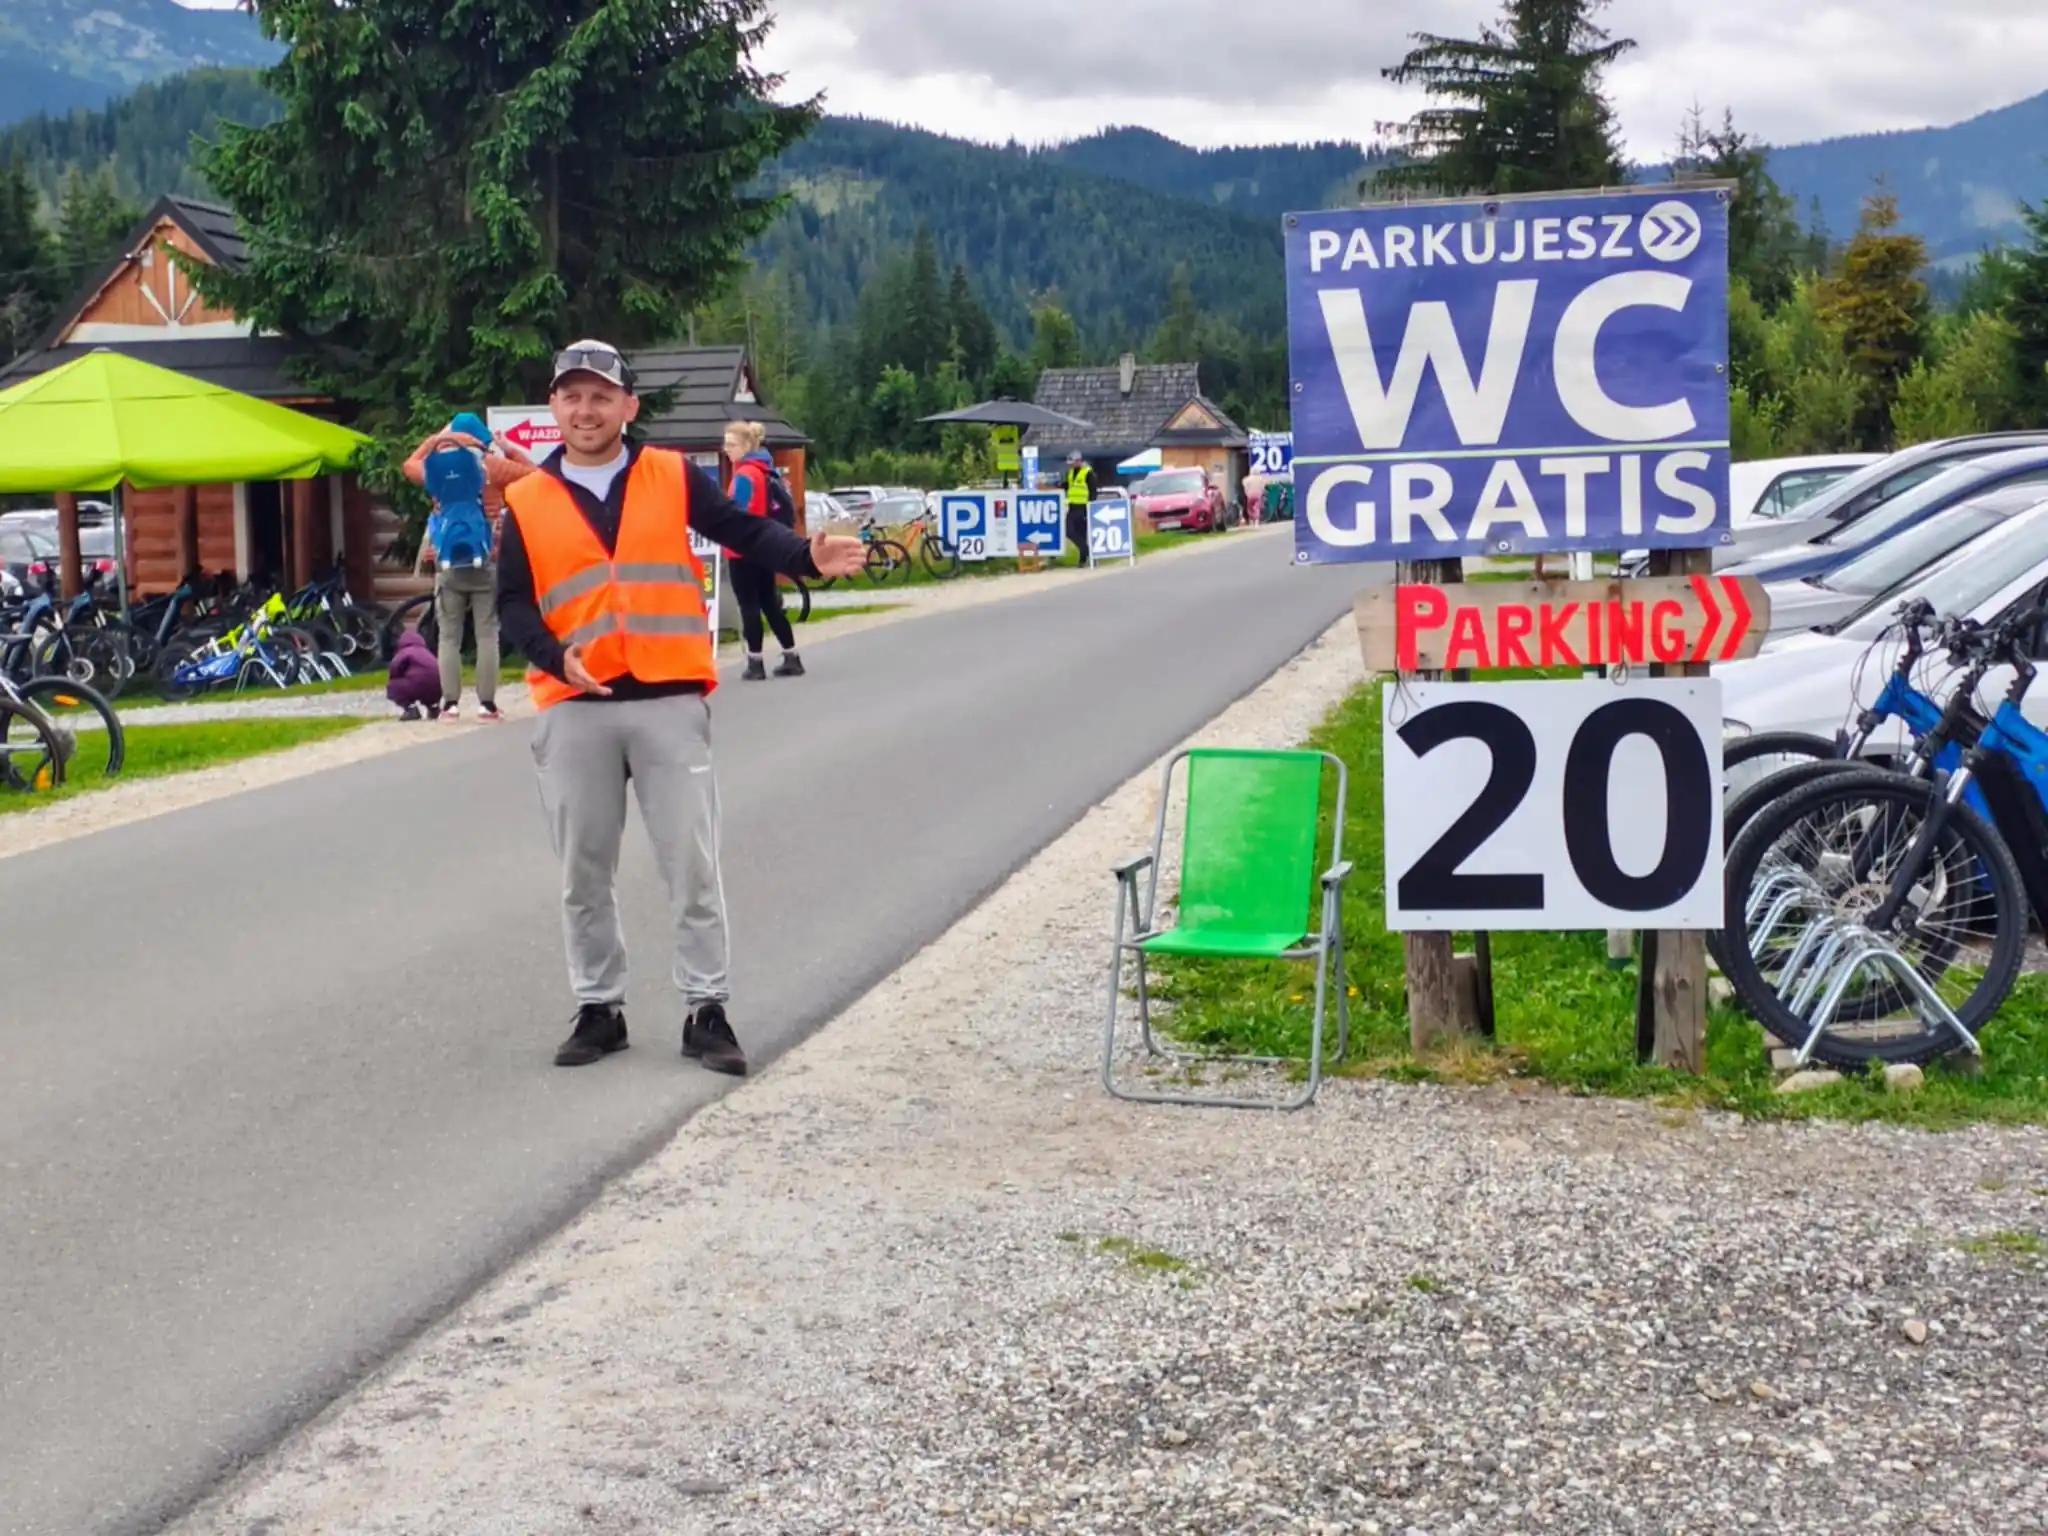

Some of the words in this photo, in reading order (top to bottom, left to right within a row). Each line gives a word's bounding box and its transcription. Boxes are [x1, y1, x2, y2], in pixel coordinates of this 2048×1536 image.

[1309, 214, 1634, 272] PARKUJESZ
[1317, 269, 1697, 450] WC
[1251, 446, 1282, 471] 20
[947, 501, 980, 546] P
[1019, 500, 1058, 524] WC
[1305, 450, 1718, 548] GRATIS
[961, 538, 985, 555] 20
[1091, 526, 1122, 553] 20
[1395, 583, 1687, 672] PARKING
[1395, 697, 1713, 913] 20
